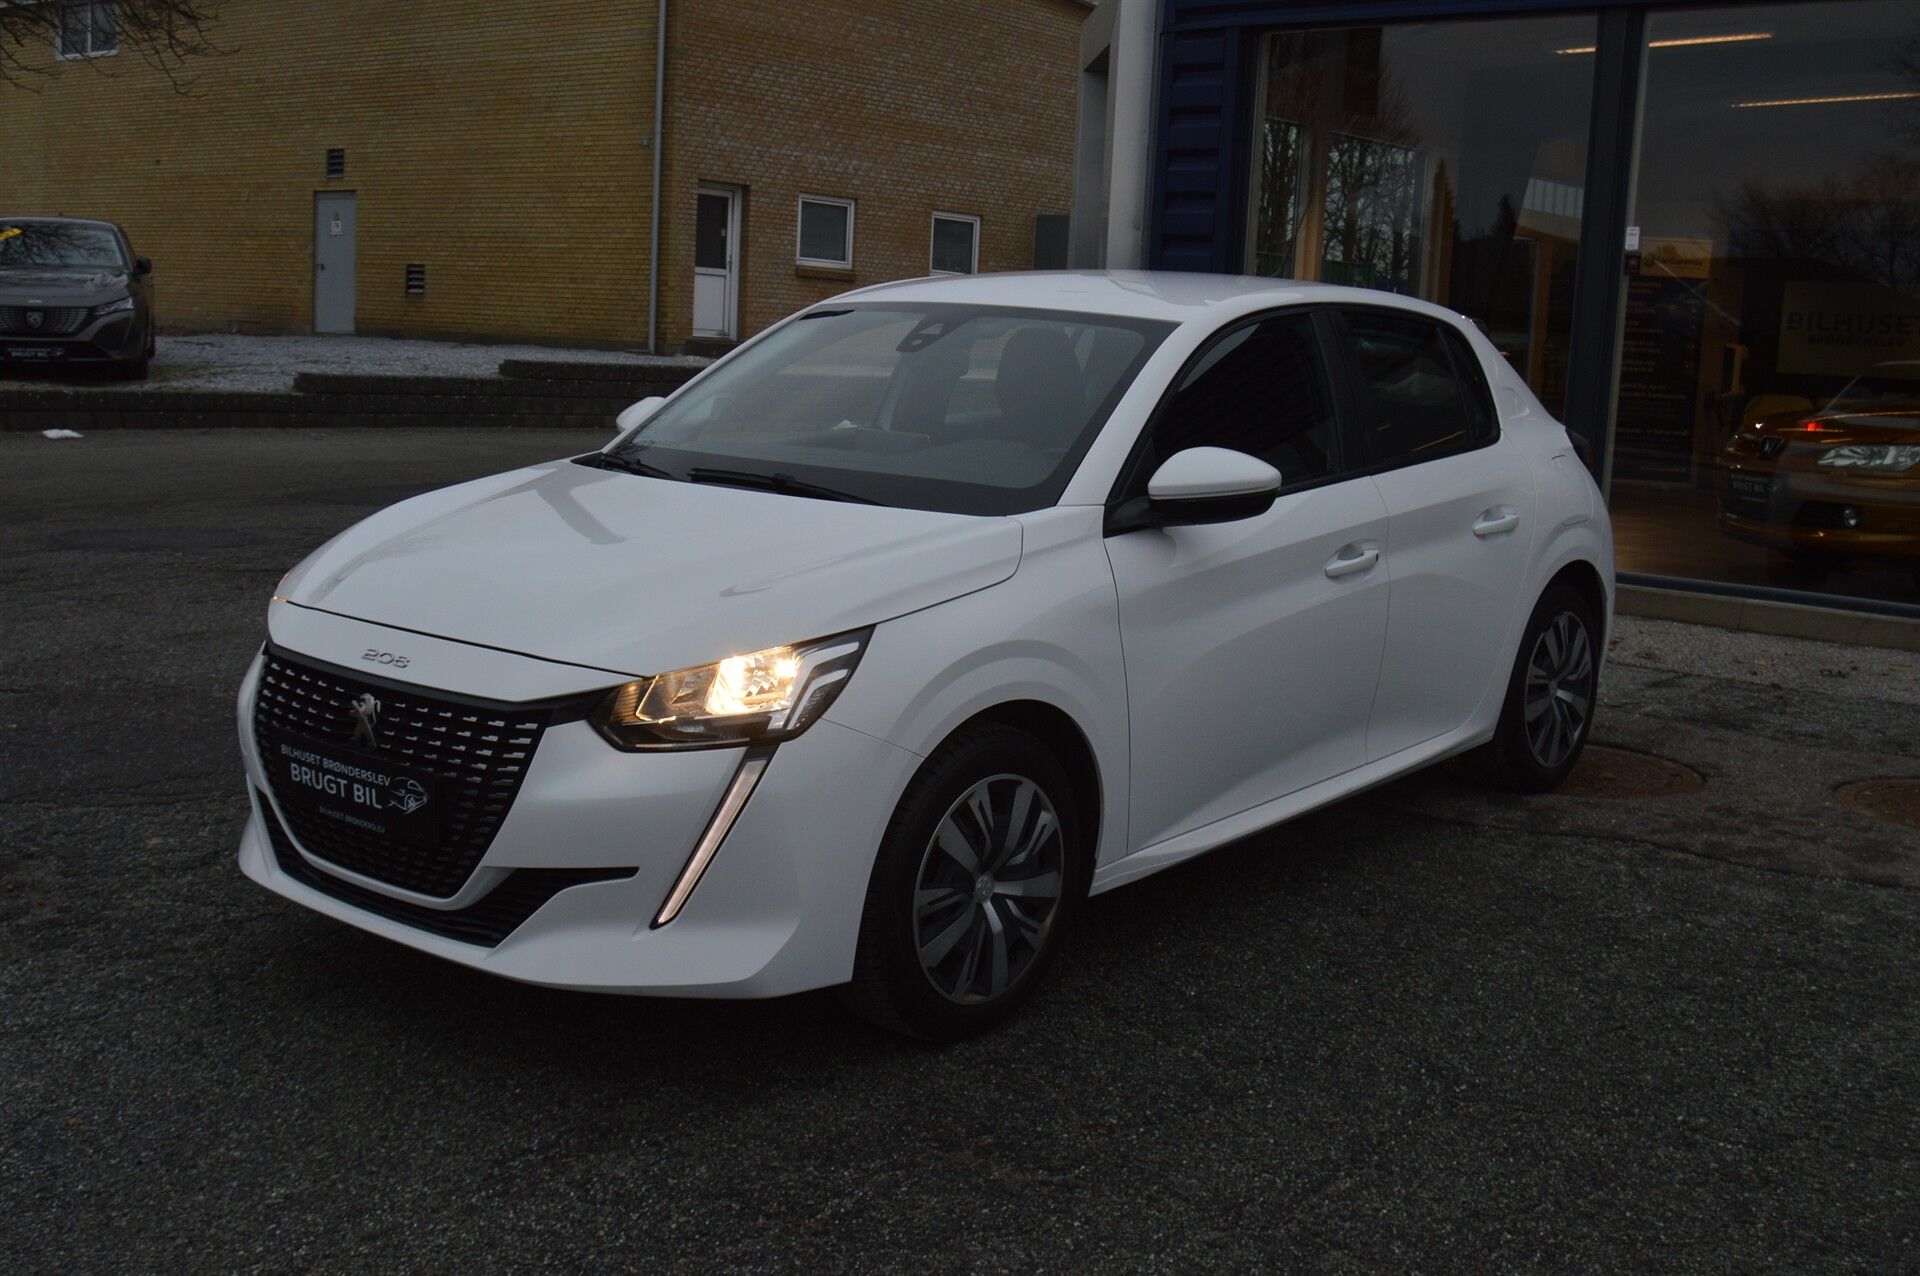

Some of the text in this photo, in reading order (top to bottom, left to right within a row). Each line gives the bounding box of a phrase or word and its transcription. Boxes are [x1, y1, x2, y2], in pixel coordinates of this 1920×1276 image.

[361, 649, 410, 668] 208
[280, 744, 391, 787] BILHUSET BRØNDERSLEV
[290, 762, 383, 809] BRUGT BIL
